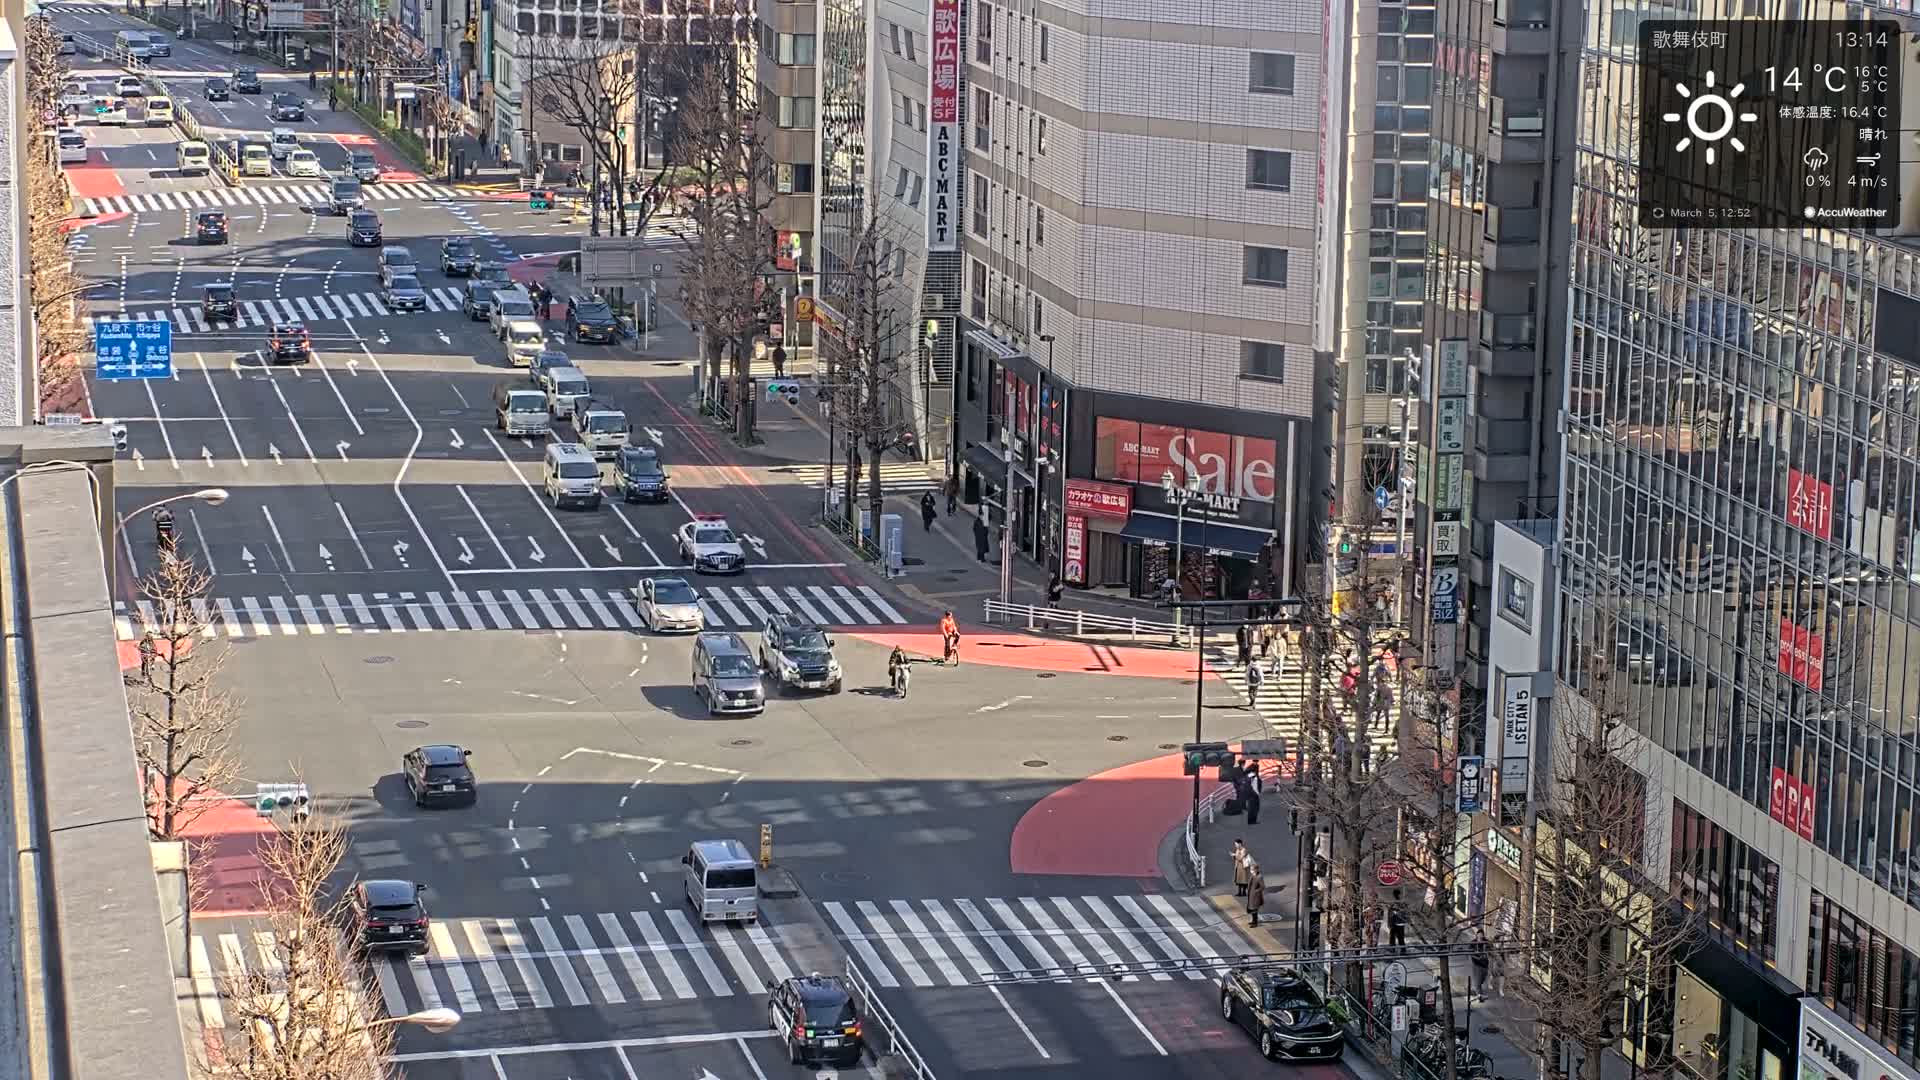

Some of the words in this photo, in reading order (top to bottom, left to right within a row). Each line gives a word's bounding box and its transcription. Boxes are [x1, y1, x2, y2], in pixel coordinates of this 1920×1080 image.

[934, 97, 955, 107] 受付
[934, 108, 955, 119] 5F
[936, 126, 949, 242] ABC-MART
[103, 323, 131, 333] 九段下
[1168, 435, 1274, 504] Sale
[1792, 480, 1828, 529] 会計
[1436, 525, 1450, 552] 買取
[1517, 690, 1529, 700] 5
[1506, 700, 1515, 718] CITY
[1506, 718, 1514, 738] PARK
[1515, 702, 1528, 745] ISETAN
